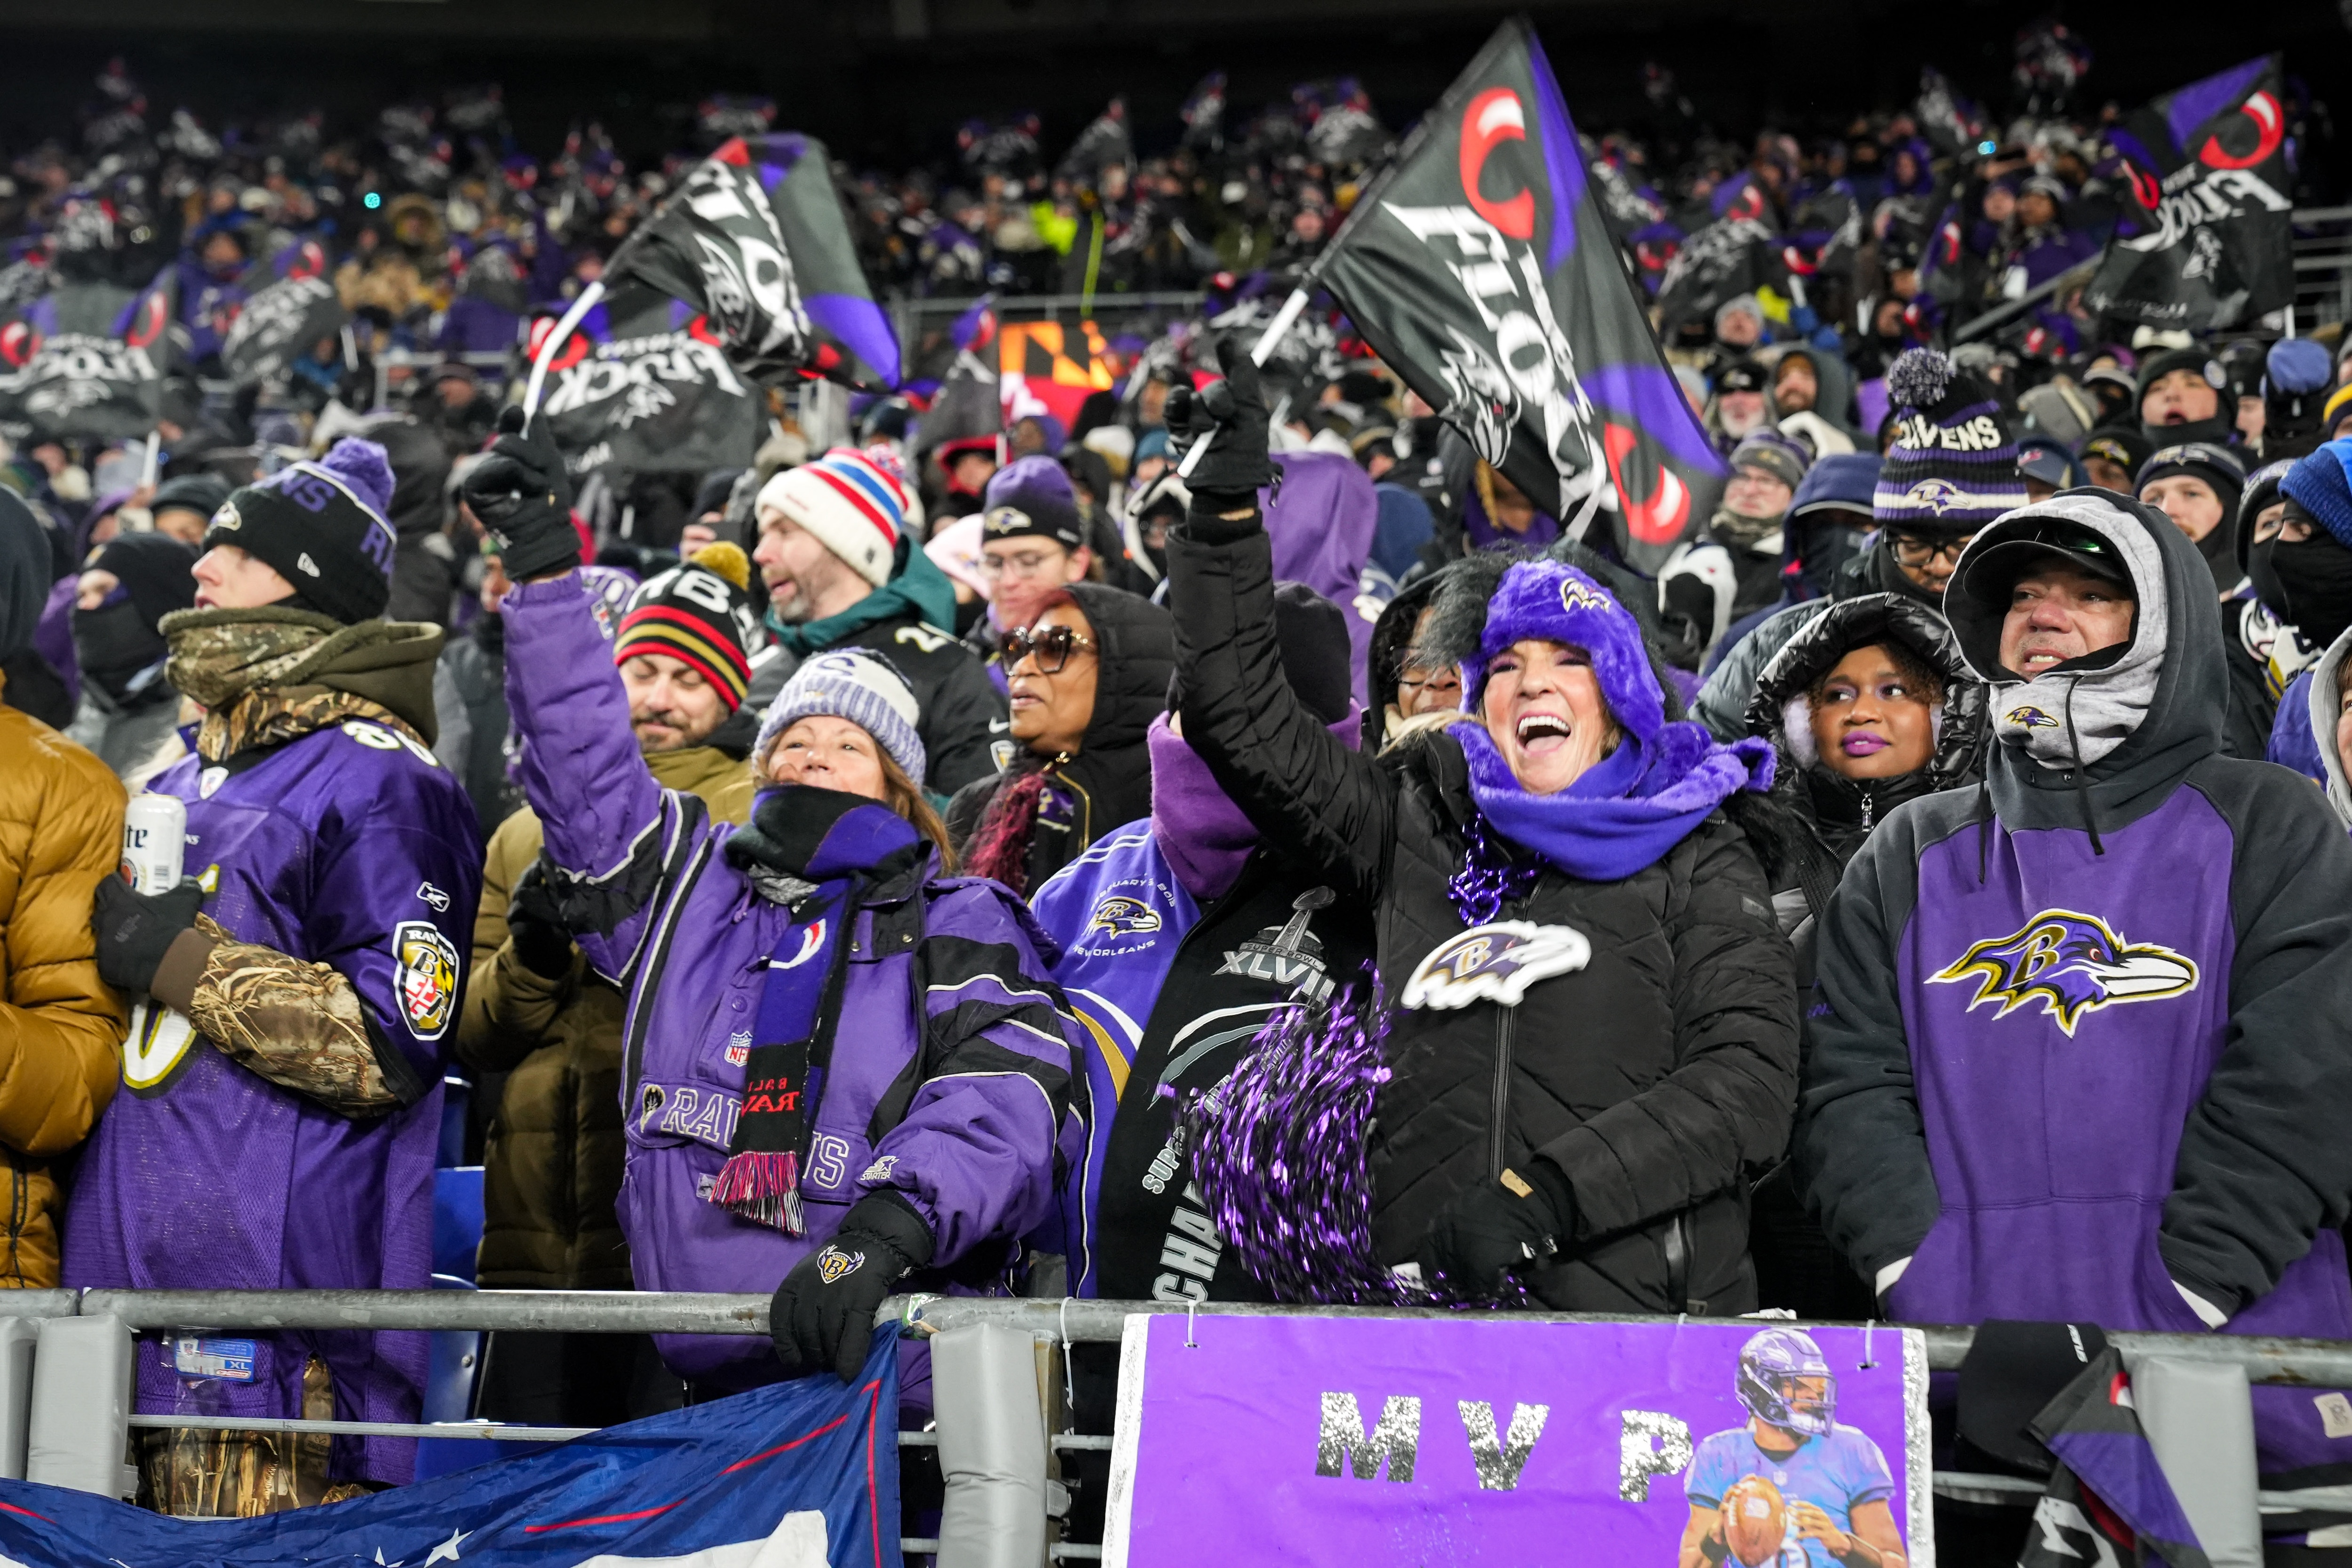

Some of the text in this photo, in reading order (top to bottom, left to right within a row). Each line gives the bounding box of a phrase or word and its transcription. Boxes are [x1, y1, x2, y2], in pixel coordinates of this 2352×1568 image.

[127, 825, 148, 849] te
[406, 930, 455, 966] RAVNS
[1092, 939, 1156, 956] ORLEANS
[1246, 943, 1319, 968] SUPER BOWL
[860, 1171, 891, 1181] STARTER
[229, 1361, 249, 1370] XL
